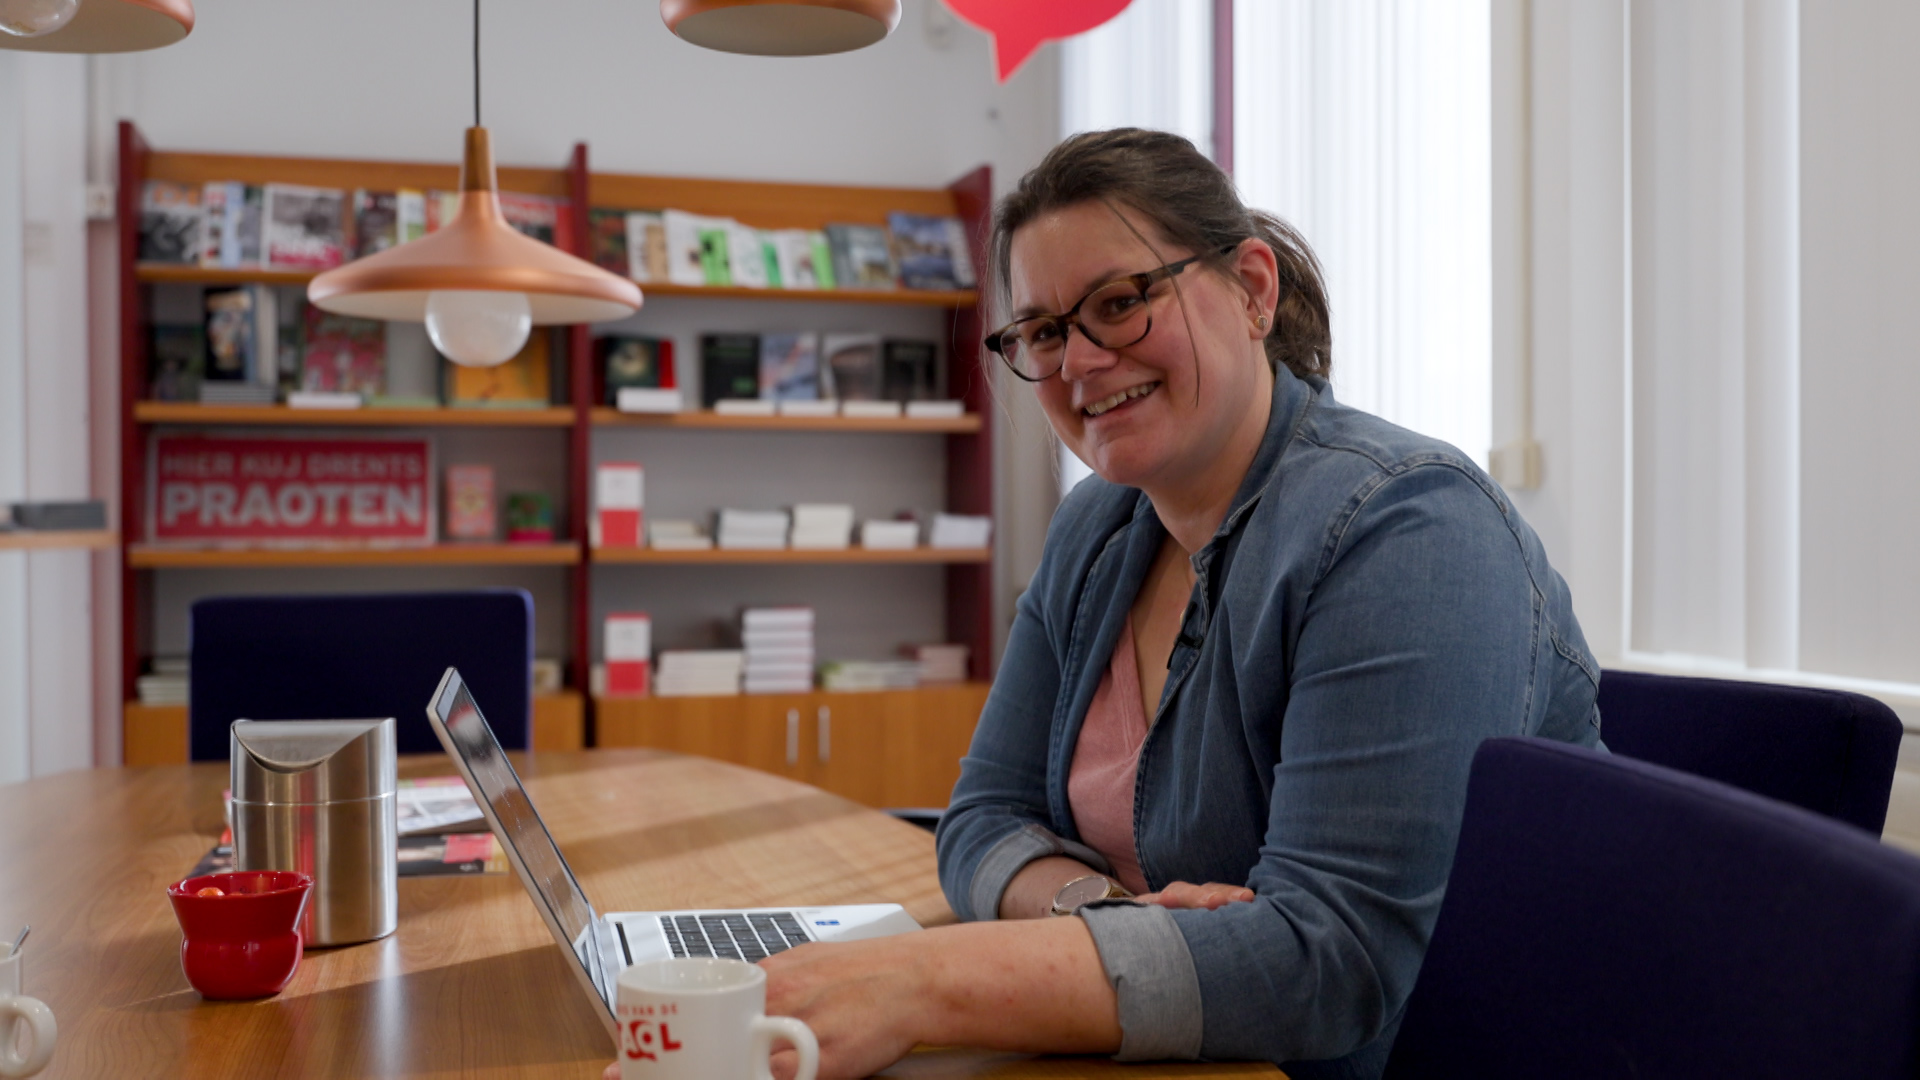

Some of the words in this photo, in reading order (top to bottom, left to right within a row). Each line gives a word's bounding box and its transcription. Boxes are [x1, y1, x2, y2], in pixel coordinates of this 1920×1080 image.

[163, 453, 234, 477] HIER
[240, 454, 301, 478] KUJ
[306, 453, 423, 479] DRENTS
[162, 481, 422, 527] PRAOTEN
